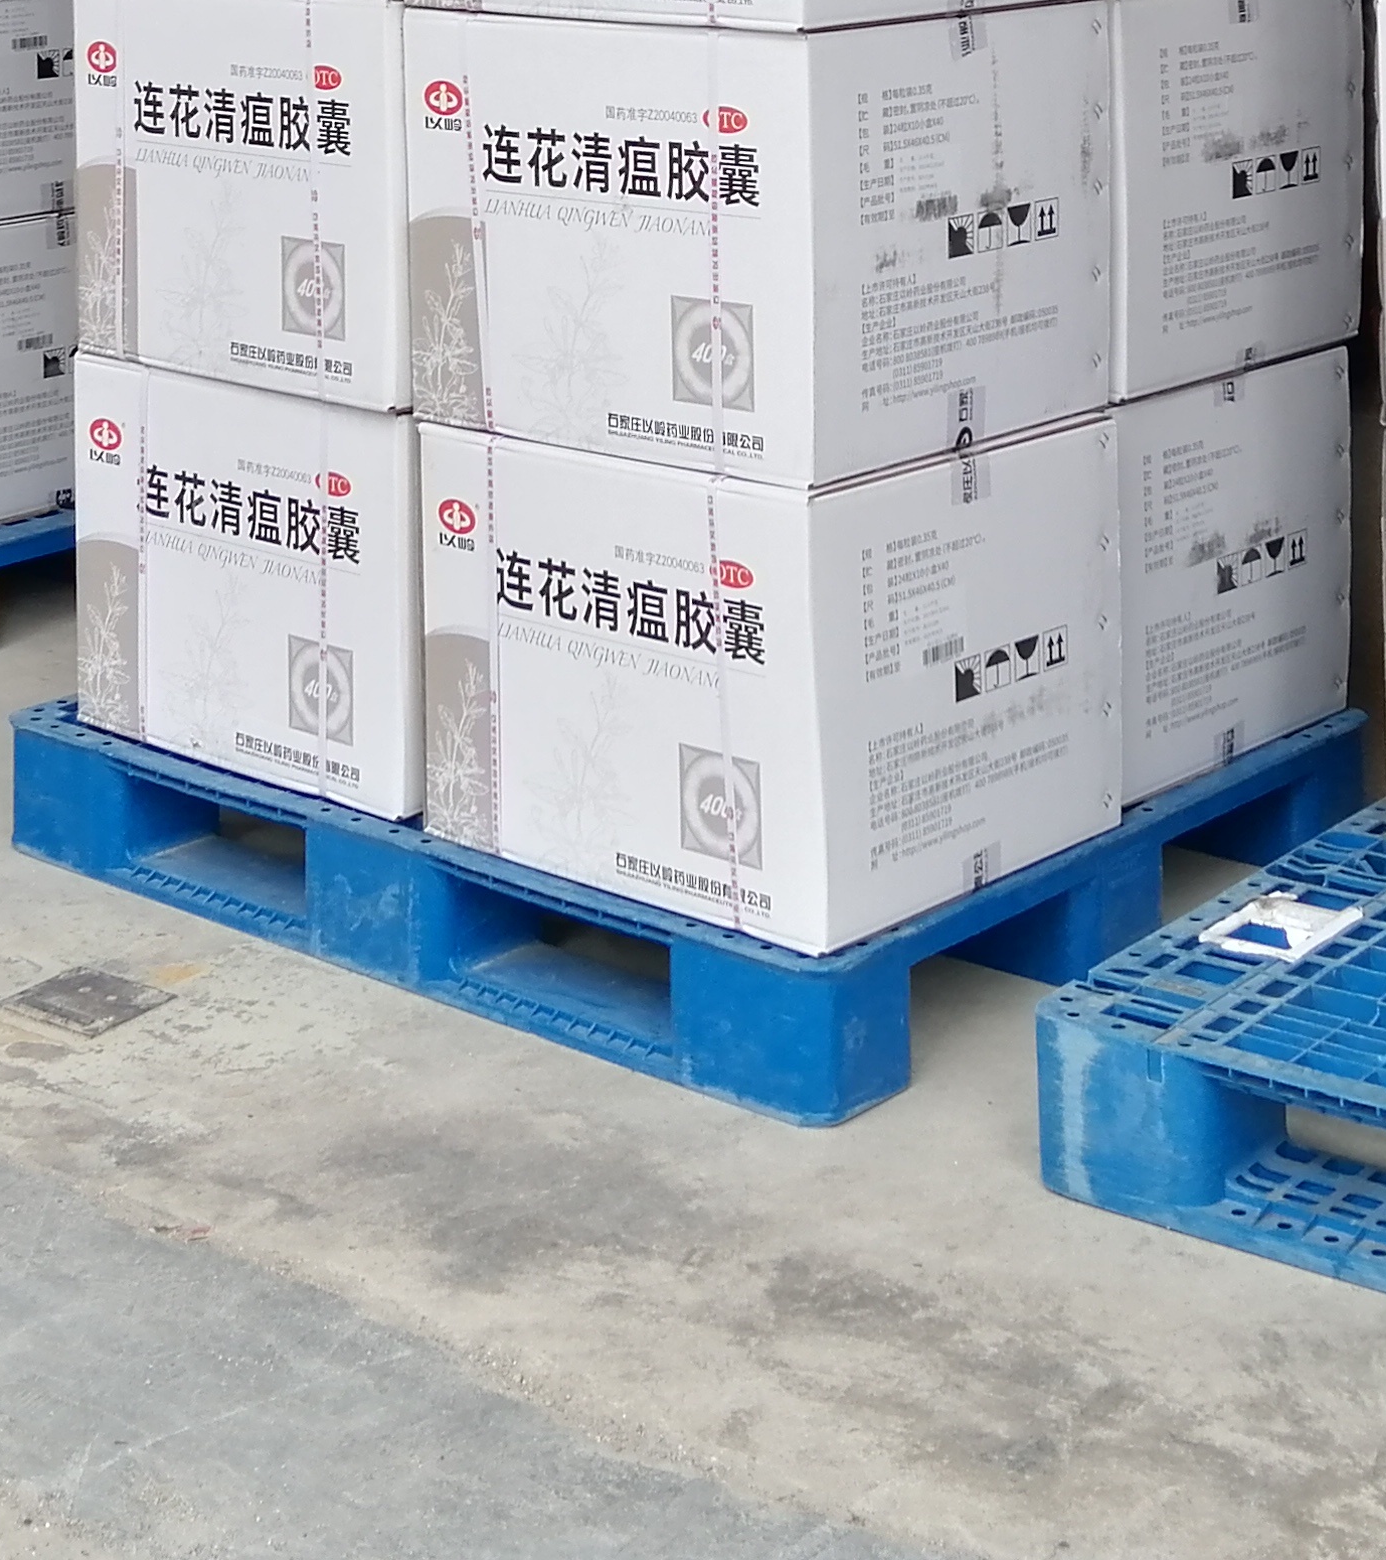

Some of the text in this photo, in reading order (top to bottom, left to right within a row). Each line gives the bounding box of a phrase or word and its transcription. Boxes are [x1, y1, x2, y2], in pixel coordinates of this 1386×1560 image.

[87, 72, 118, 88] 以岭
[230, 62, 303, 84] 国药准字Z20040063
[134, 81, 351, 156] 连花清瘟胶囊
[424, 116, 462, 132] 以岭
[604, 103, 698, 127] 国药准字Z20040063
[134, 147, 309, 190] LIANHUA QINGWEN JIAONAN
[482, 124, 759, 207] 连花清瘟胶囊
[484, 197, 710, 245] LIANHUA QINGWEN JIAONAN
[692, 341, 734, 369] 40盒
[607, 412, 764, 452] 石家庄以岭药业股份限公司
[90, 447, 121, 467] 以岭
[143, 528, 192, 555] IANHUA
[196, 541, 259, 577] QINGWEN
[438, 532, 475, 553] 以岭
[614, 543, 705, 578] 国药准字Z20040063
[496, 548, 765, 665] 连花清瘟胶囊
[498, 620, 561, 652] LIANHUA
[566, 637, 642, 678] QINGWEN
